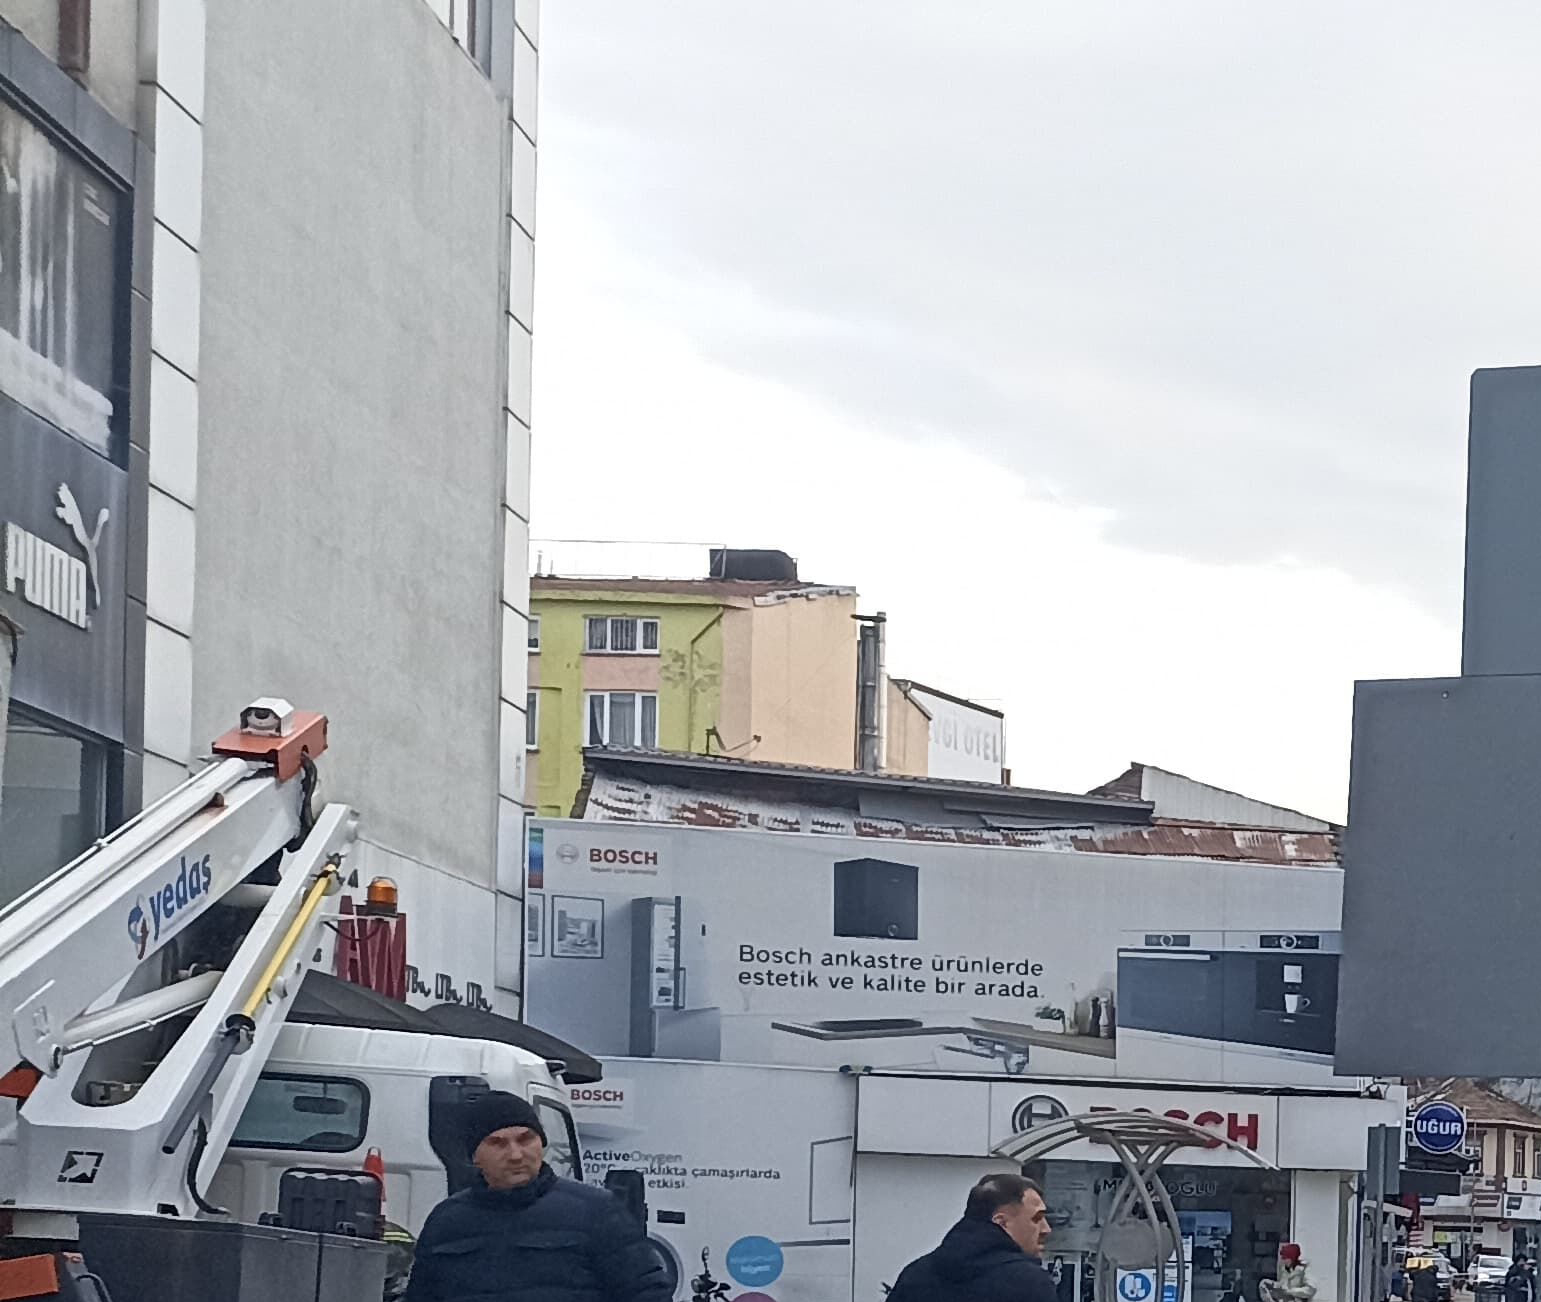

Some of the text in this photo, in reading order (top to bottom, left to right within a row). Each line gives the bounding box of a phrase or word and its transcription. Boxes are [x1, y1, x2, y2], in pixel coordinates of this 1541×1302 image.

[7, 521, 87, 629] PUMA
[590, 848, 658, 865] BOSCH
[149, 853, 211, 941] yedaş
[739, 945, 1044, 976] Bosch ankastre ürünlerde
[738, 970, 1045, 999] estetik ve kalite bir arada.
[571, 1089, 624, 1101] BOSCH
[1416, 1118, 1461, 1135] UĞUR
[647, 1178, 685, 1190] etkisi
